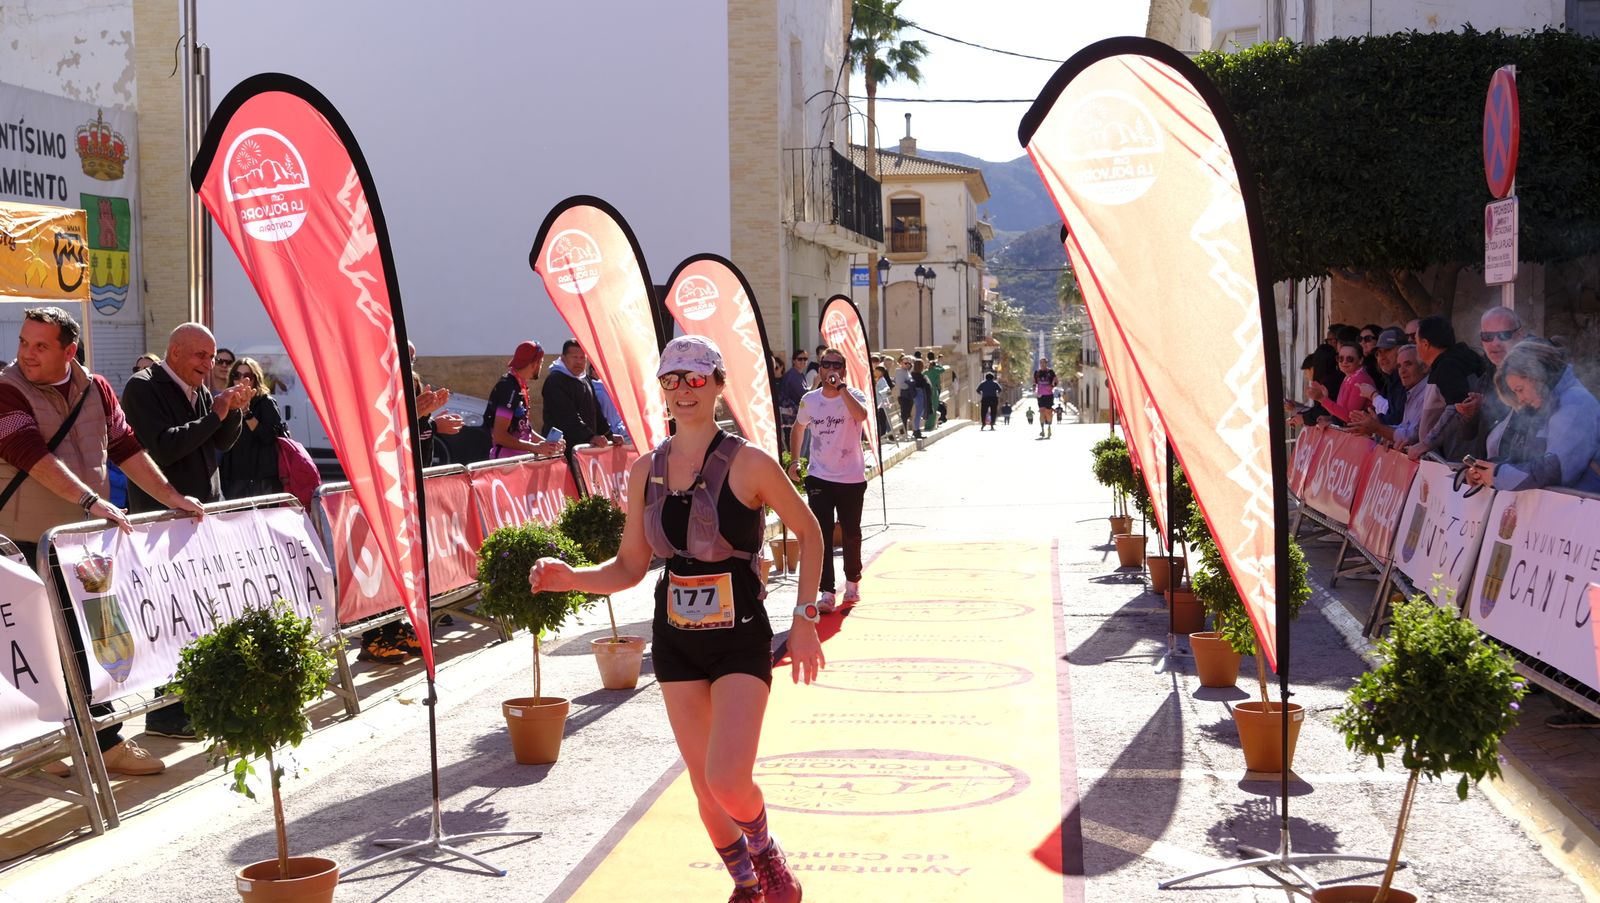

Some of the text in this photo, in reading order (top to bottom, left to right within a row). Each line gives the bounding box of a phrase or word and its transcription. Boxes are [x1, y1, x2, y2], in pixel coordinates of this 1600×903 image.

[131, 539, 310, 590] AYUNTAMIENTO DE
[139, 566, 323, 643] CANTORIA
[673, 588, 716, 607] 177
[901, 853, 950, 862] de
